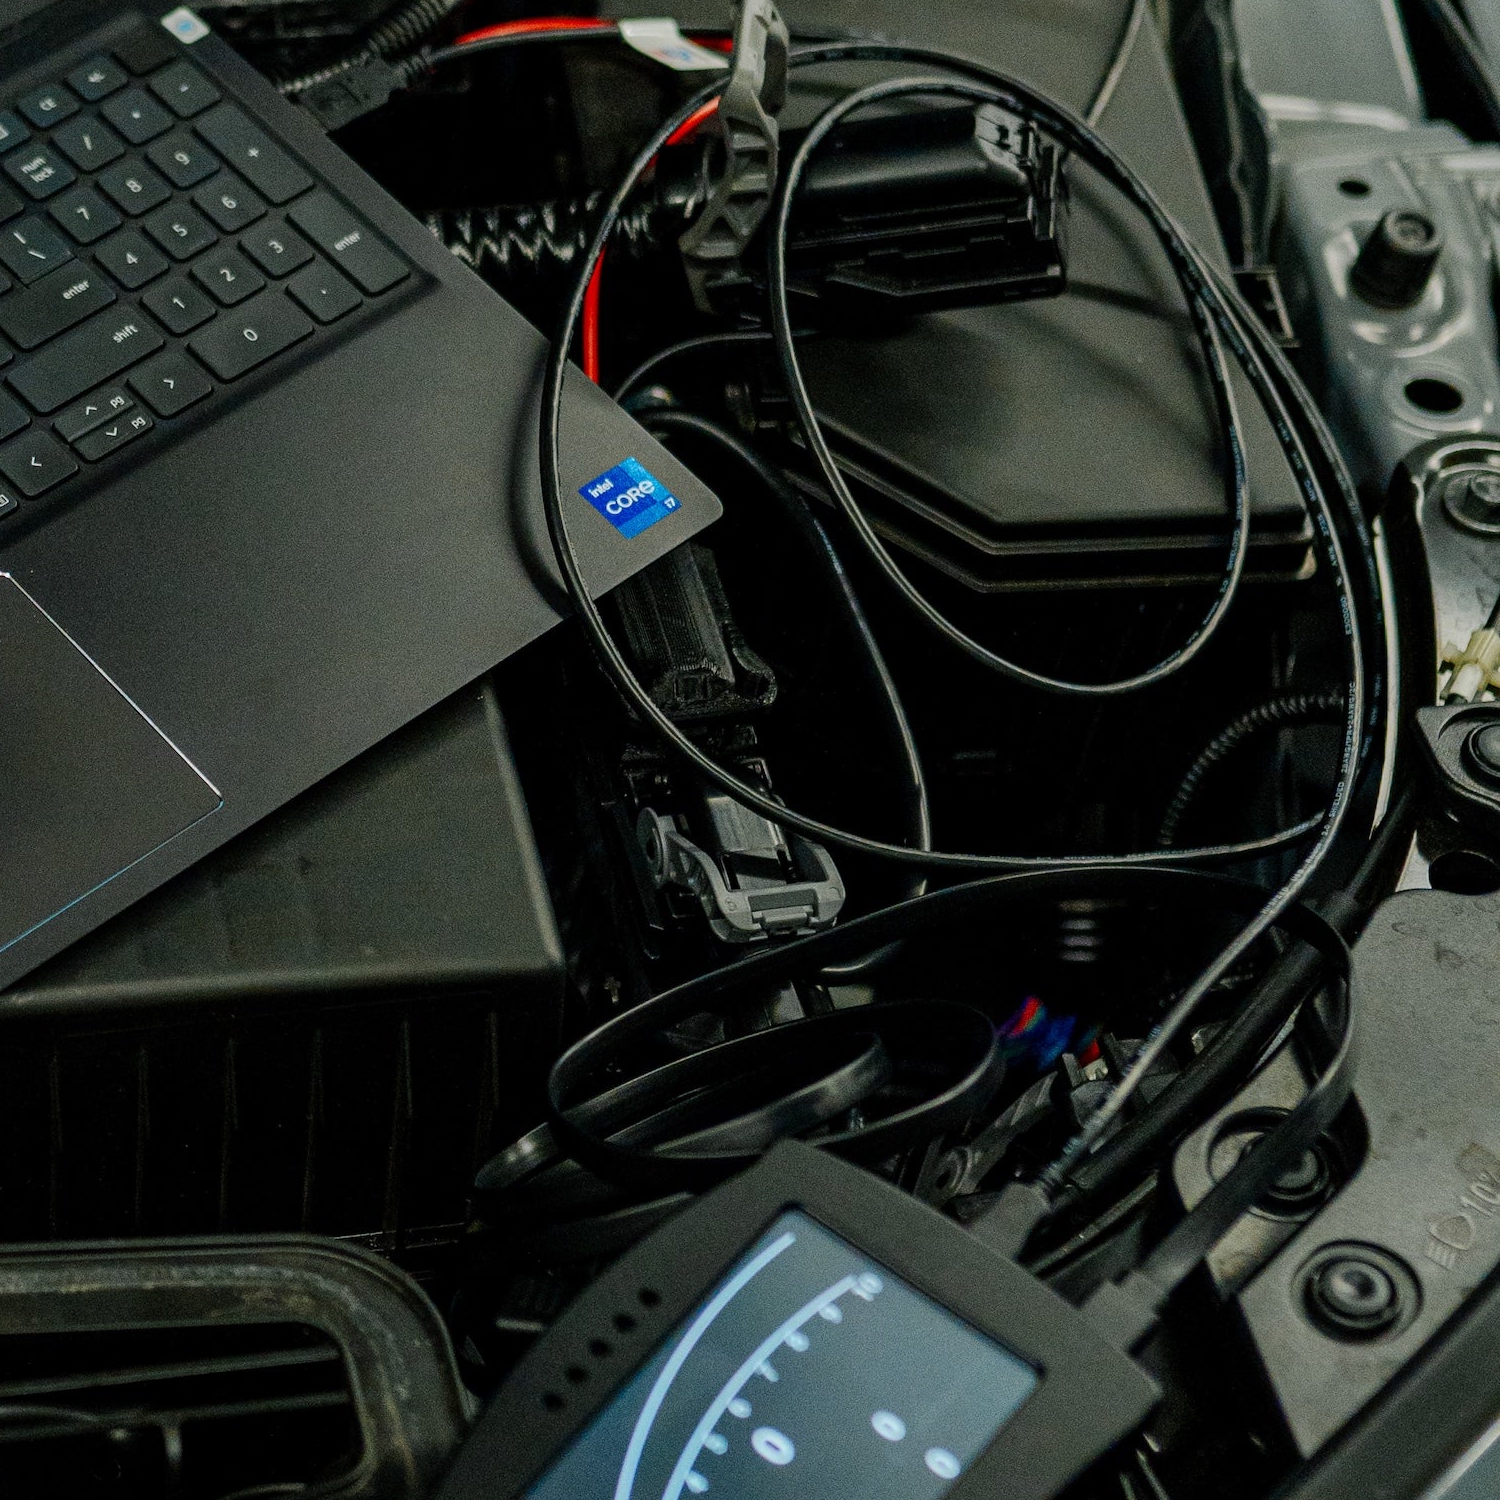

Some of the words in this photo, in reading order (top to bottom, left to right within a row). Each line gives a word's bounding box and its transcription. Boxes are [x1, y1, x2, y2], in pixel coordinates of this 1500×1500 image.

[335, 232, 360, 250] enter
[63, 281, 89, 299] enter
[113, 325, 138, 343] shift
[588, 478, 615, 498] intel
[664, 497, 677, 510] i7
[1328, 781, 1346, 819] SHIELDED
